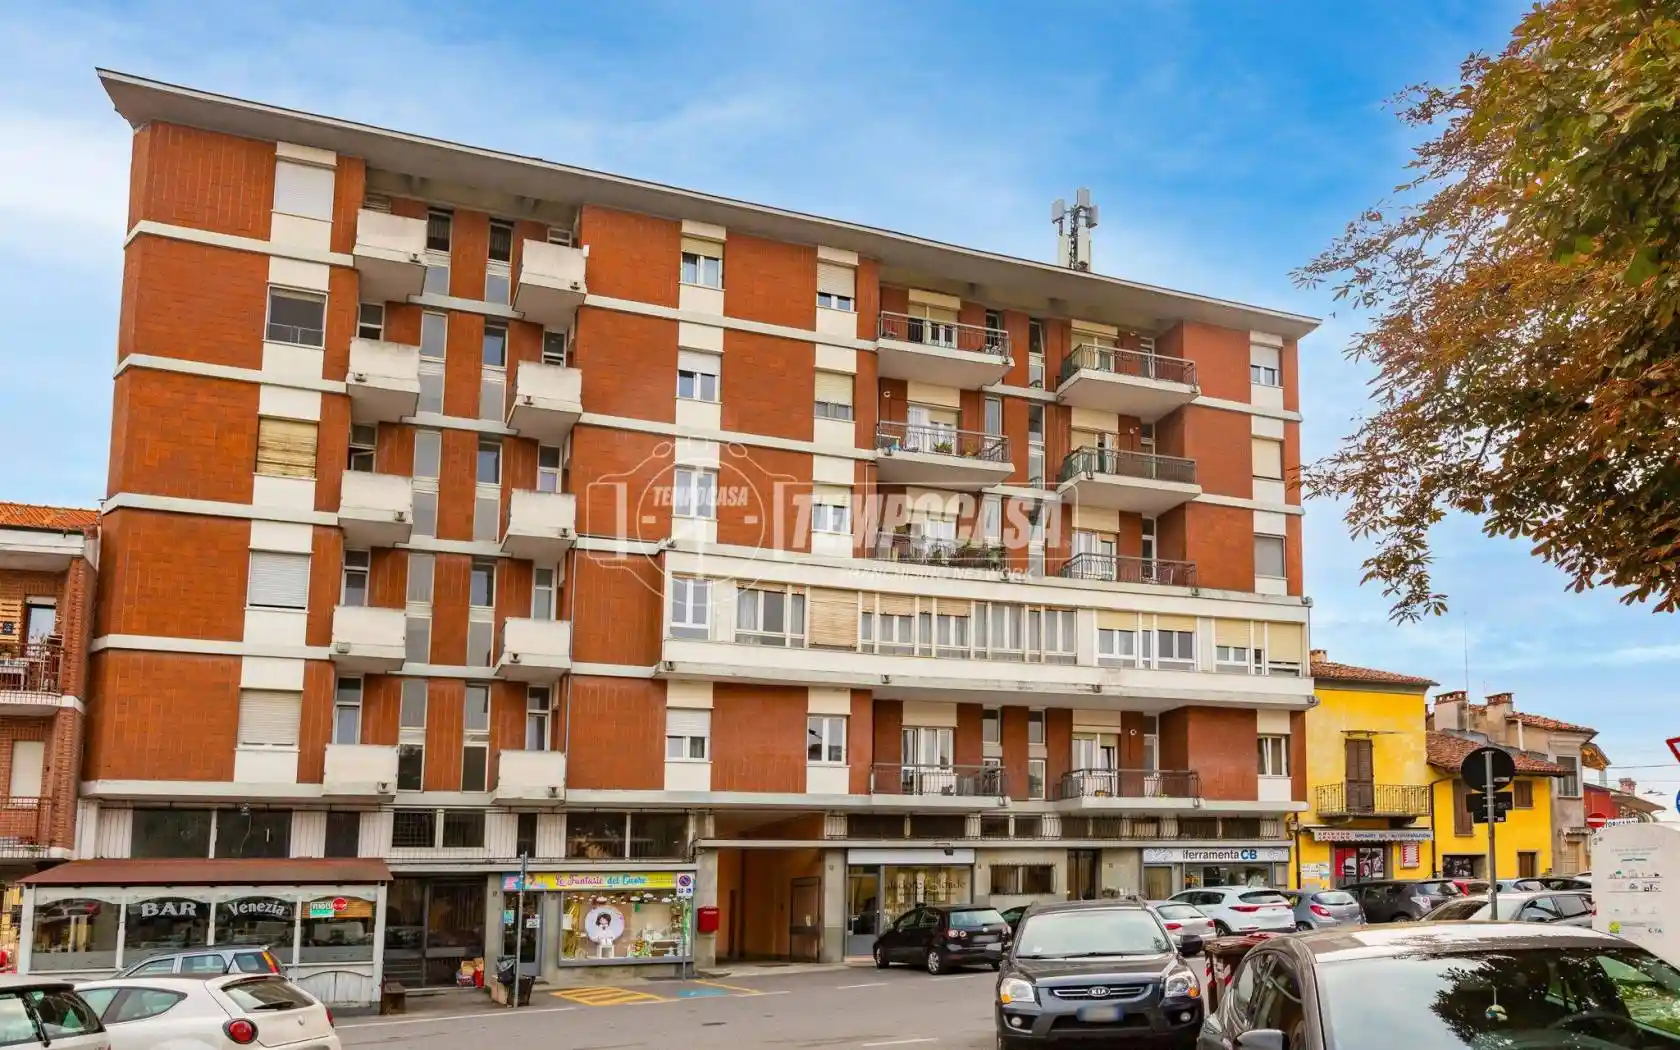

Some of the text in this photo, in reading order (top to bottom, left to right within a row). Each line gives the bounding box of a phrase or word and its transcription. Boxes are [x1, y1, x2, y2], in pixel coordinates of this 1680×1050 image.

[1240, 849, 1257, 859] CB
[141, 900, 285, 917] BAR Venezia
